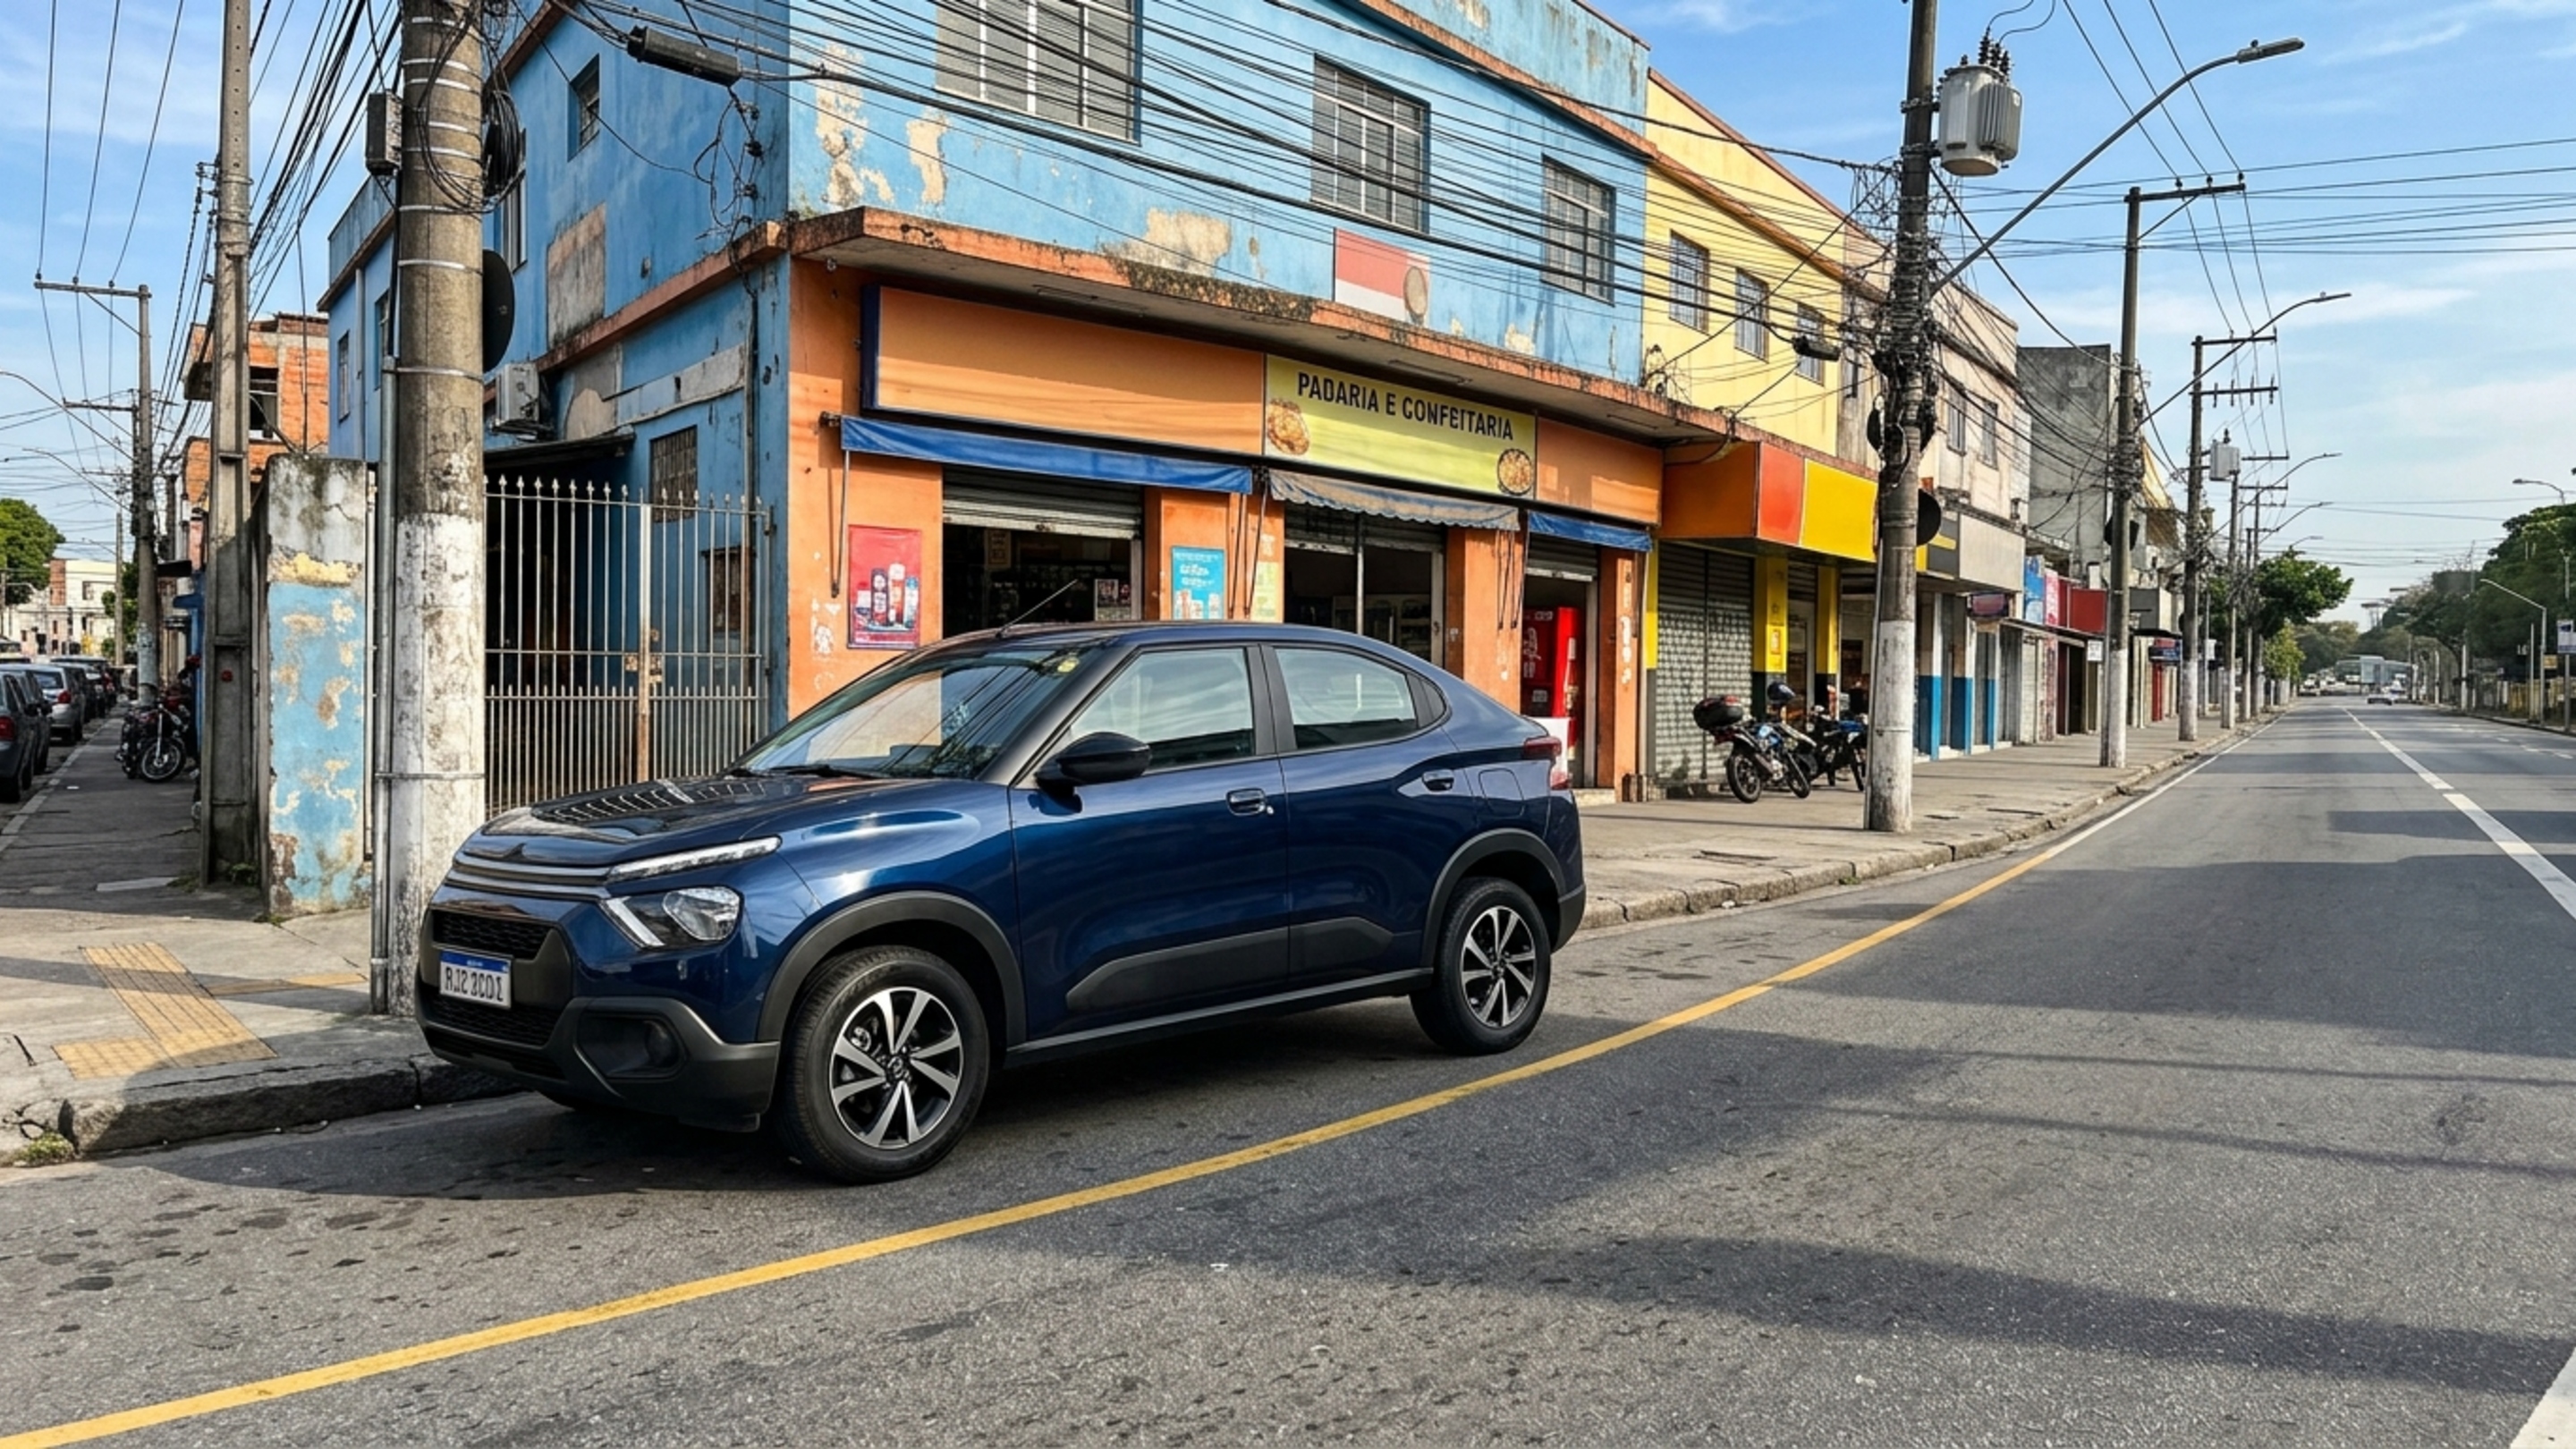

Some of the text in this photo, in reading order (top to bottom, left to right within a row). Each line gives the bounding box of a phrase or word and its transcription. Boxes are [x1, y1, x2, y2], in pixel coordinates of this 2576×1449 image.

[1298, 372, 1513, 440] PADARIA E CONFEITARIA
